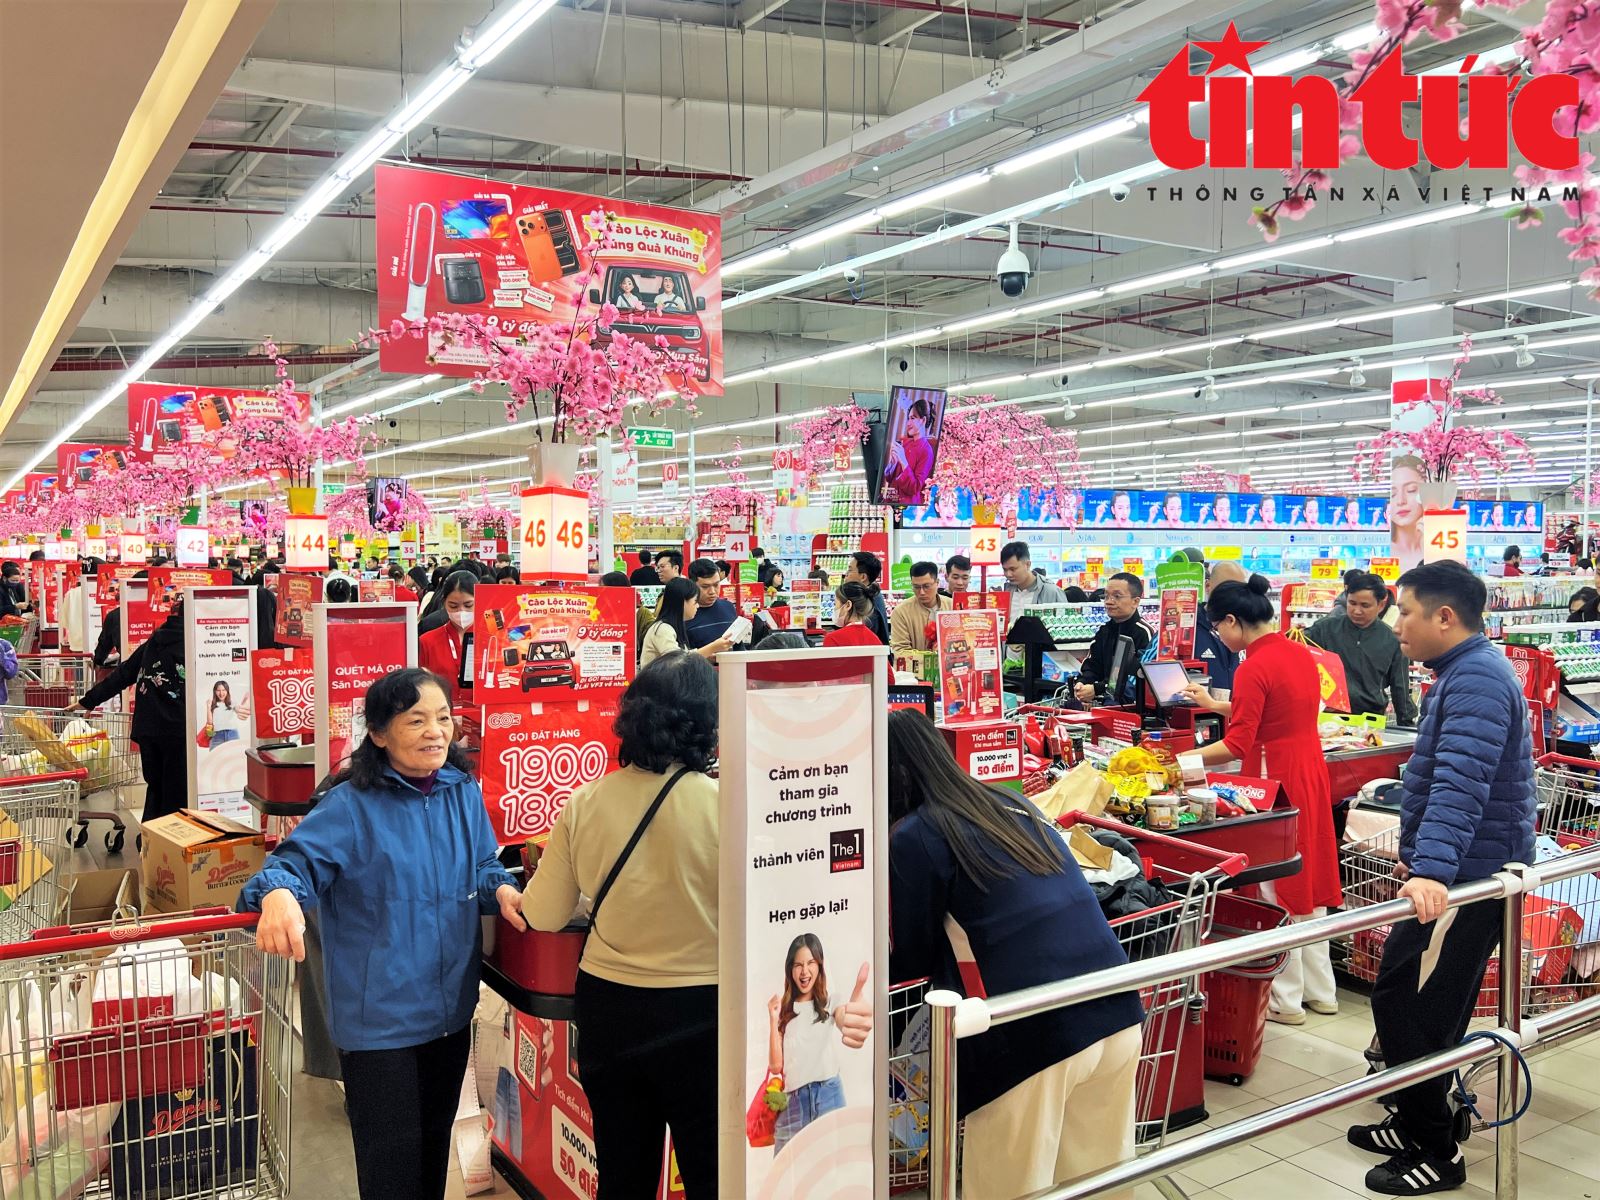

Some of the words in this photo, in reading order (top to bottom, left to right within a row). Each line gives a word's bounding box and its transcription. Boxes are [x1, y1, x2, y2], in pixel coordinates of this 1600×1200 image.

[635, 225, 657, 239] Lộc
[660, 229, 690, 245] Xuân
[664, 246, 700, 262] Khủng
[525, 520, 546, 548] 46
[556, 520, 583, 549] 46
[1431, 530, 1459, 549] 45
[127, 544, 143, 554] 40
[187, 540, 204, 552] 42
[302, 534, 325, 551] 44
[404, 546, 415, 554] 35
[731, 541, 744, 552] 41
[975, 538, 996, 551] 43
[1318, 568, 1331, 576] 79
[547, 598, 563, 607] Lộc
[565, 598, 587, 606] Xuân
[578, 626, 587, 637] 9
[589, 627, 599, 639] tỷ
[335, 663, 366, 676] QUÉT
[367, 663, 384, 675] MÃ
[332, 679, 351, 689] Săn
[508, 733, 528, 743] GỌI
[531, 729, 550, 742] ĐẶT
[553, 728, 581, 738] HÀNG
[971, 733, 986, 742] Tích
[987, 729, 1004, 740] điểm
[499, 740, 609, 792] 1900
[977, 754, 996, 762] 10.000
[768, 766, 800, 781] Cảm
[803, 766, 820, 778] ơn
[824, 764, 849, 777] bạn
[977, 765, 990, 776] 50
[991, 760, 1014, 774] điểm
[779, 787, 814, 801] tham
[817, 785, 839, 800] gia
[765, 808, 817, 824] chương
[820, 802, 852, 818] trình
[753, 852, 793, 869] thành
[796, 848, 825, 863] viên
[835, 860, 860, 870] Vietnam
[768, 909, 796, 924] Hẹn
[799, 905, 826, 921] gặp
[828, 898, 849, 914] lại!
[554, 1083, 566, 1102] Tích
[566, 1095, 580, 1115] điểm
[560, 1122, 587, 1158] 10.000
[559, 1146, 576, 1183] 50
